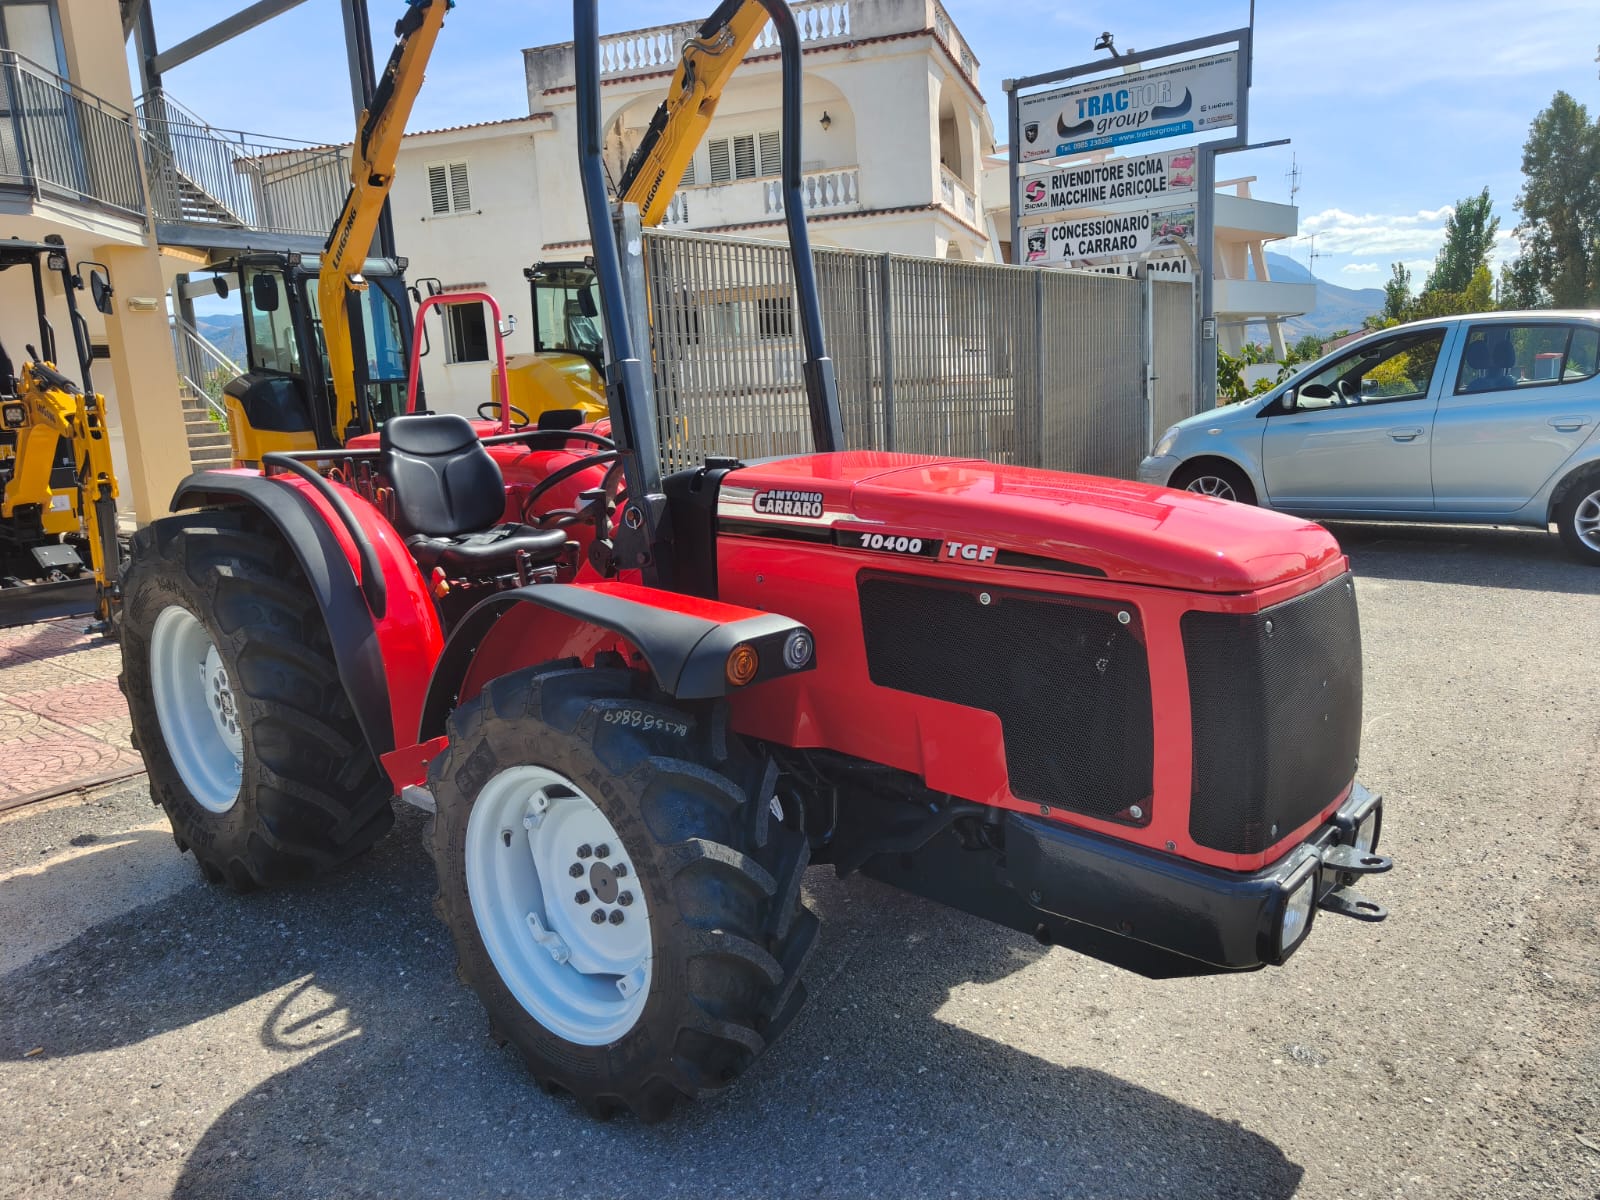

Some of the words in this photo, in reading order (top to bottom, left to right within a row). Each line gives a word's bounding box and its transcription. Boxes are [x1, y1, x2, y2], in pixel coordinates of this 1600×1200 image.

[1075, 80, 1172, 119] TRACTOR
[1096, 110, 1149, 135] group
[1118, 123, 1187, 142] www.tractorgroup.it
[1052, 165, 1124, 190] RIVENDITORE
[1127, 158, 1164, 177] SICMA
[1050, 186, 1107, 207] MACCHINE
[1109, 176, 1167, 198] AGRICOLE
[1024, 201, 1048, 210] SICMA
[332, 206, 357, 270] LIUGONG
[1052, 215, 1149, 241] CONCESSIONARIO
[1063, 243, 1074, 257] A.
[1079, 234, 1137, 255] CARRARO
[754, 493, 823, 517] CARRARO
[767, 490, 823, 502] ANTONIO
[860, 533, 923, 553] 10400
[946, 541, 995, 561] TGF
